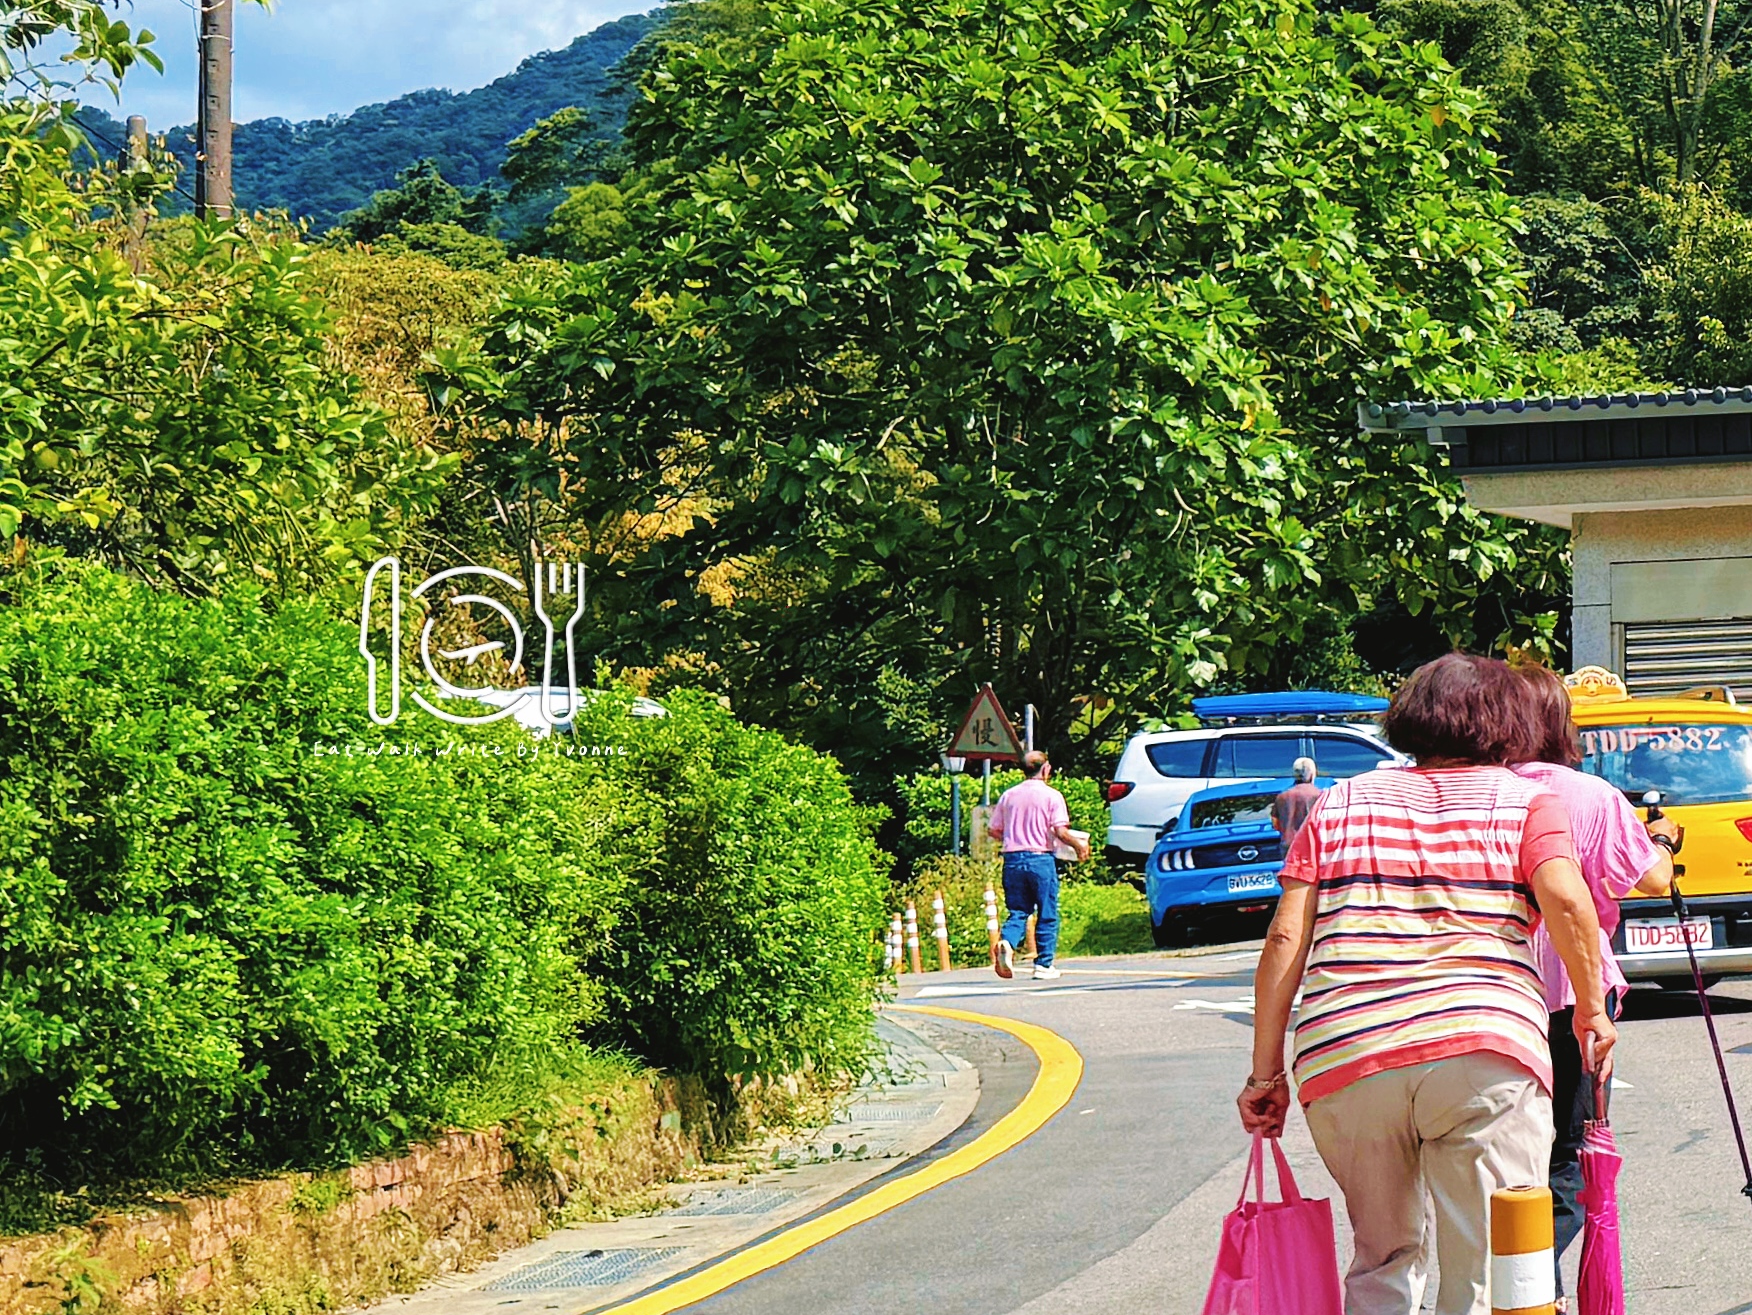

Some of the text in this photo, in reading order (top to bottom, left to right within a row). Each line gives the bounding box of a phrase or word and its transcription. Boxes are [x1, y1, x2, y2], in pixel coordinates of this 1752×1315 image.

[972, 717, 999, 747] 慢
[1580, 727, 1727, 755] TDD-5882
[1627, 922, 1709, 947] TDD-5882
